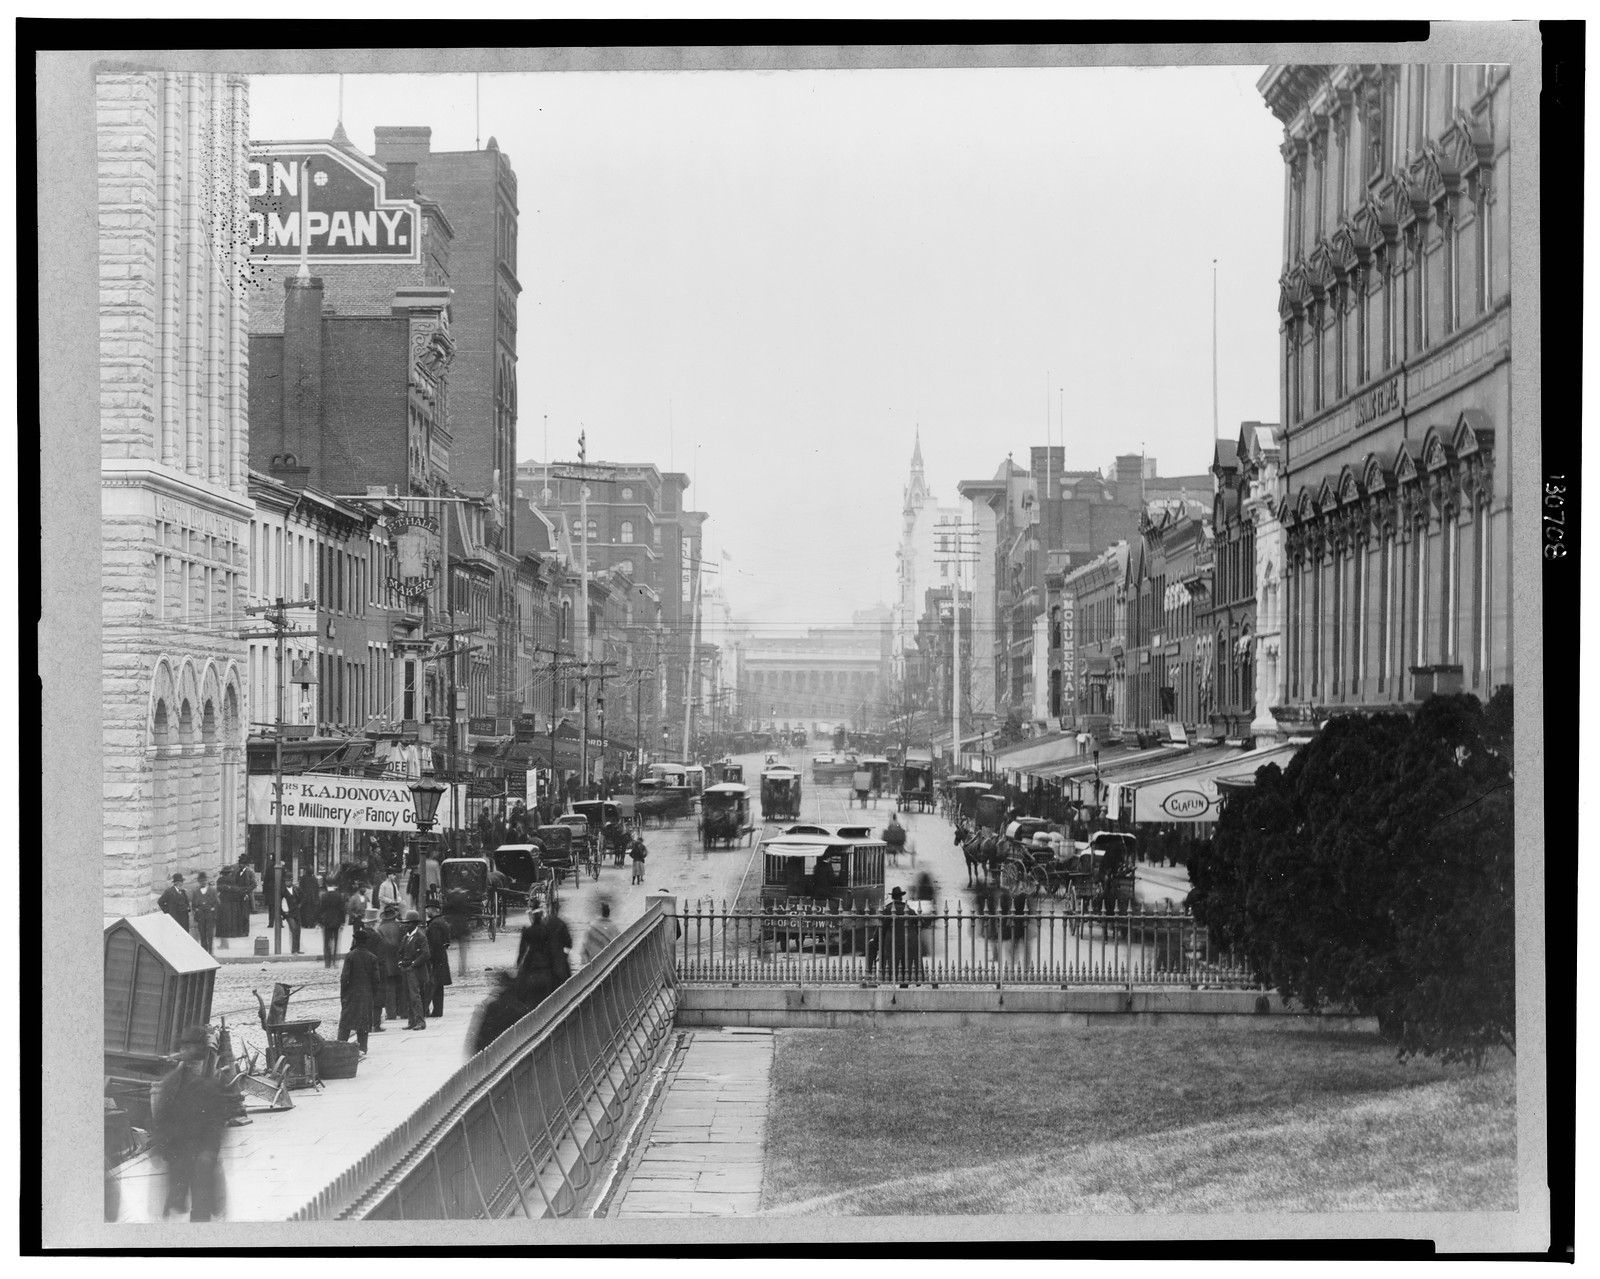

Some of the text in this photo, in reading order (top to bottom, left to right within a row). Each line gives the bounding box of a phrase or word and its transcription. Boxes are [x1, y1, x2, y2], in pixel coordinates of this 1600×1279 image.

[271, 801, 295, 817] Fne
[299, 803, 352, 824] Millinery
[366, 807, 400, 826] Fancy
[402, 809, 441, 826] Gos.
[1171, 799, 1204, 813] CLAFLIN
